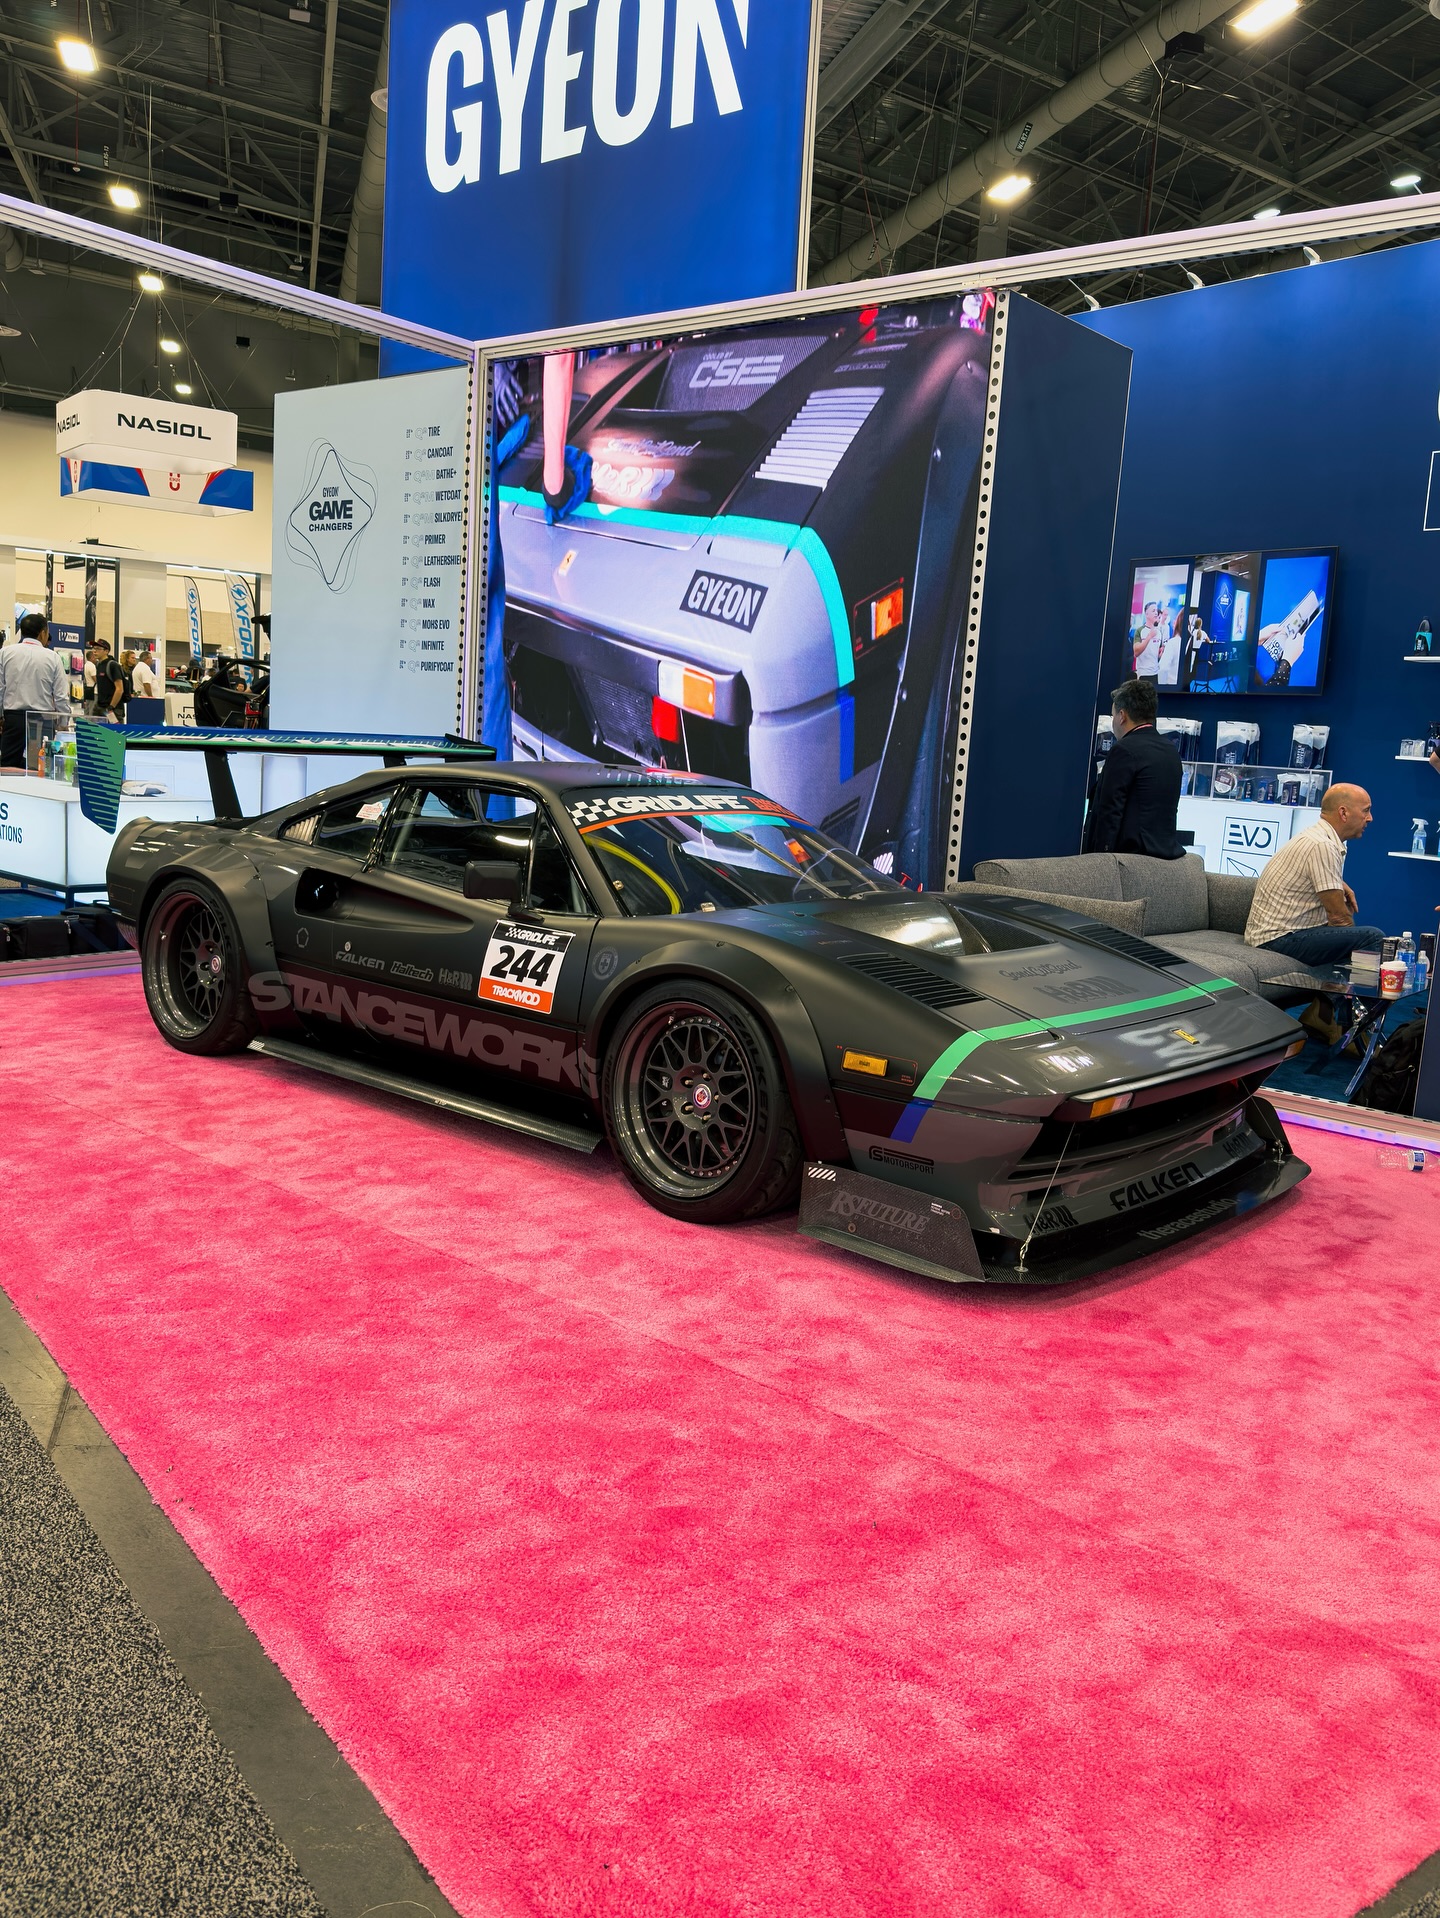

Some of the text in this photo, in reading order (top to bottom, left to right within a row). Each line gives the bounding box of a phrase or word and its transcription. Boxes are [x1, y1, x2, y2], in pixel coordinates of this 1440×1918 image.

[425, 0, 749, 194] GYEON
[57, 413, 81, 434] NASIOL
[117, 413, 212, 440] NASIOL
[428, 426, 440, 437] TIRE
[427, 446, 454, 459] CANCOAT
[436, 468, 457, 480] BATHE+
[322, 486, 340, 498] GYEON
[435, 489, 462, 501] WETCOAT
[309, 500, 353, 521] GAME
[308, 522, 353, 532] CHANGERS
[424, 534, 446, 545] PRIMER
[423, 577, 441, 588] FLASH
[422, 598, 436, 608] WAX
[687, 575, 762, 627] GYEON
[422, 619, 439, 630] MOHS
[439, 619, 450, 630] EVO
[421, 640, 445, 651] INFINITE
[420, 661, 454, 672] PURIFYCOAT
[605, 795, 749, 815] GRIDLIFE
[518, 928, 560, 946] GRIDLIFE
[335, 951, 386, 970] FALKEN
[391, 962, 433, 981] Haltech
[489, 944, 556, 987] 244
[492, 985, 540, 1006] TRACKMOD
[247, 970, 600, 1099] STANCEWORKS
[729, 1013, 768, 1136] FALKEN
[883, 1156, 935, 1175] MOTORSPORT
[1109, 1161, 1204, 1212] FALKEN
[856, 1197, 931, 1234] FUTURE
[1137, 1197, 1238, 1240] theracestudio
